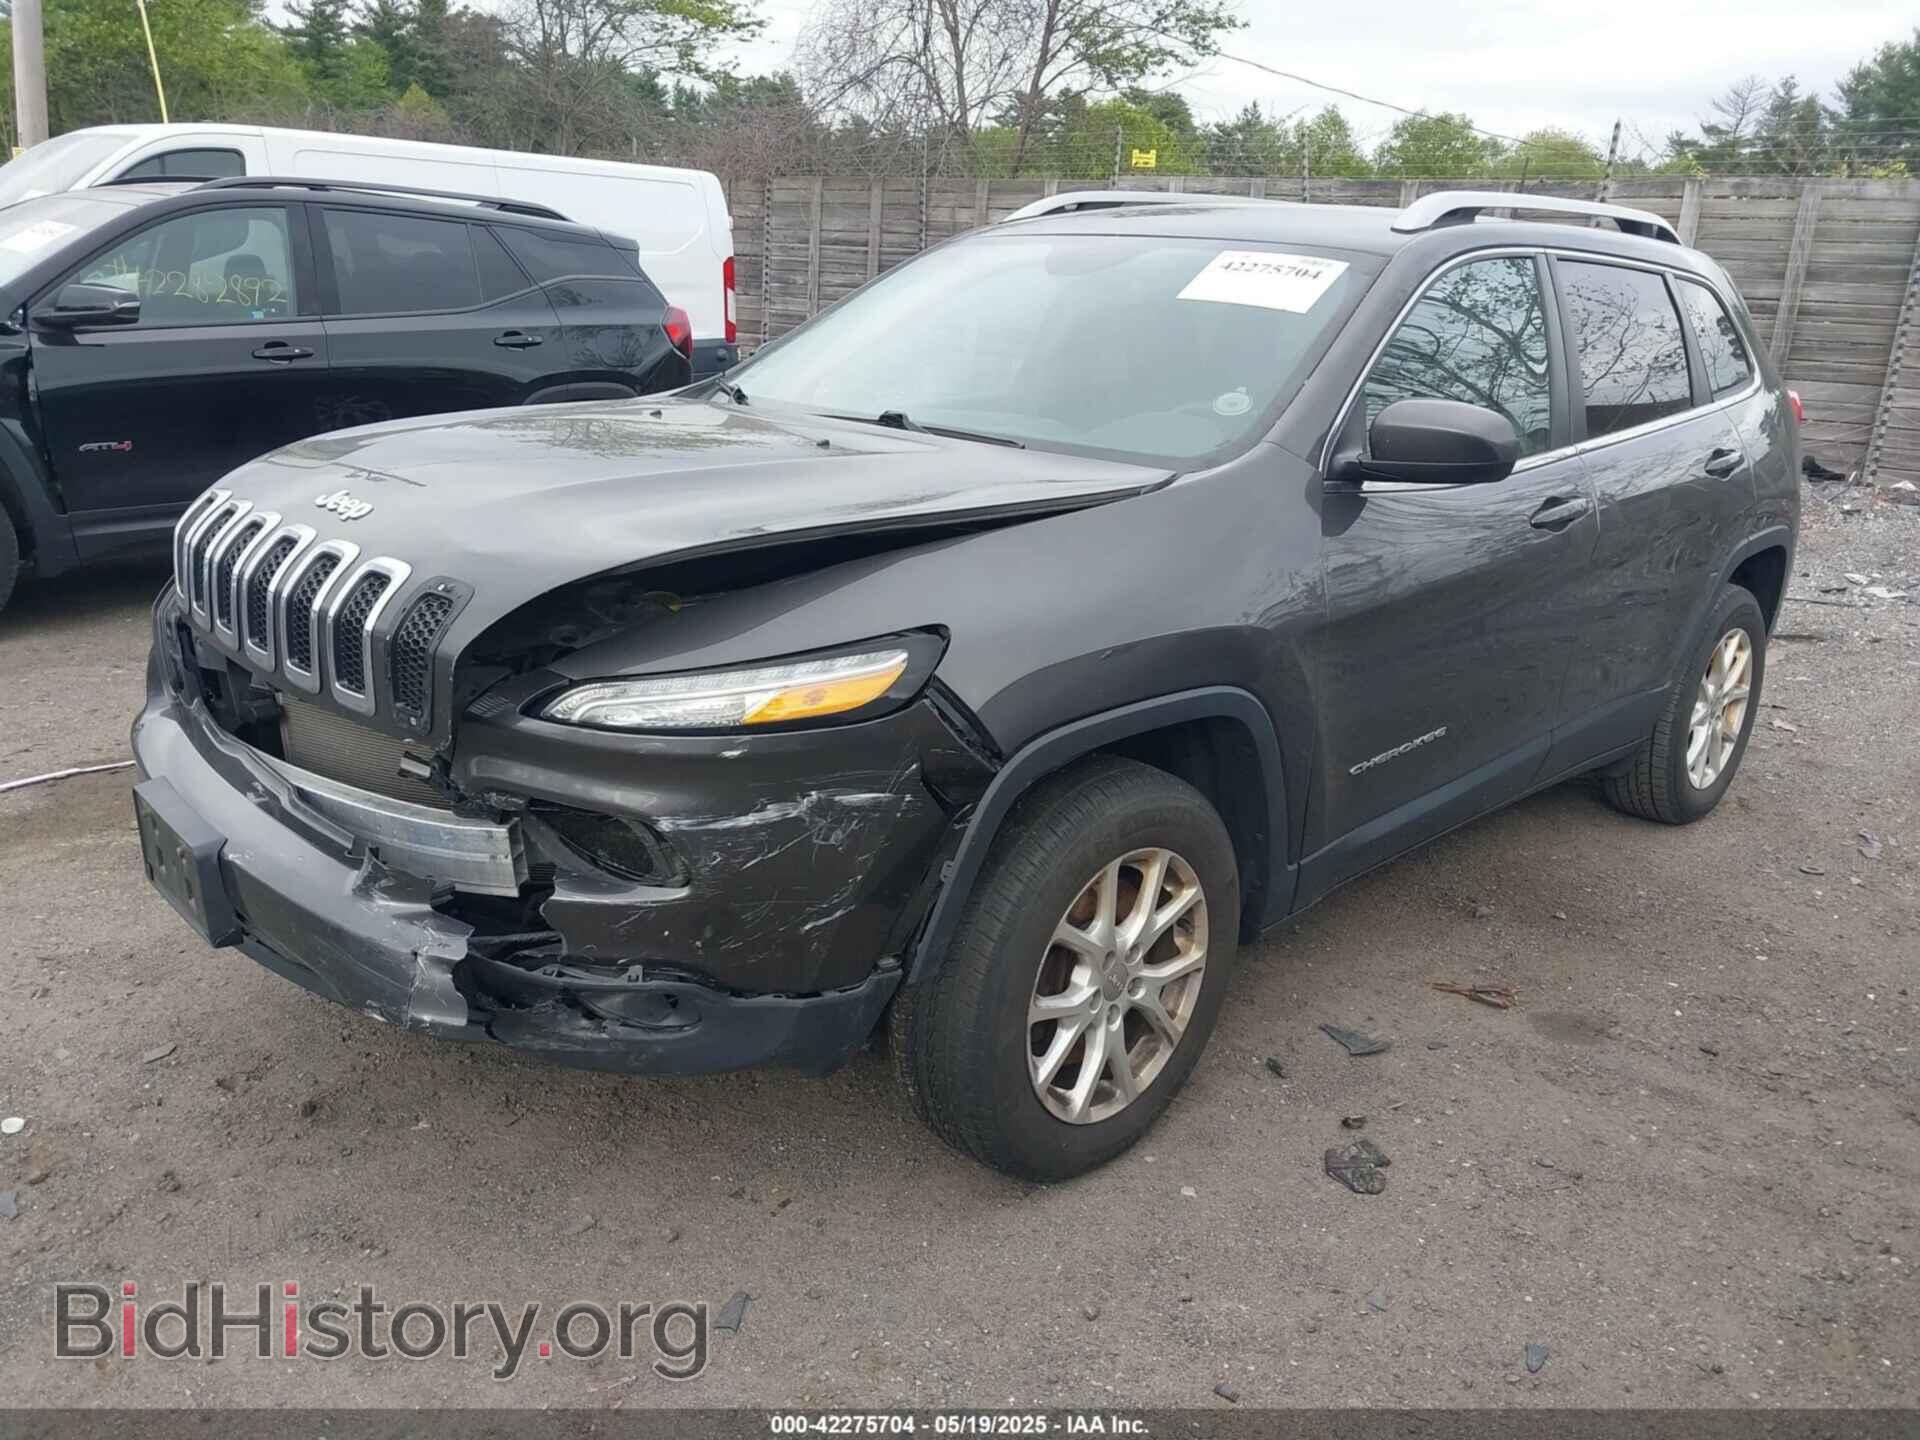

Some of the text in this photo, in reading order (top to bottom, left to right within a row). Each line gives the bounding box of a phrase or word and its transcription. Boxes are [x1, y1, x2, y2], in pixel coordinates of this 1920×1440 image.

[1221, 261, 1323, 279] 42275704
[315, 490, 373, 520] Jeep
[1349, 726, 1447, 775] CHEROKEE
